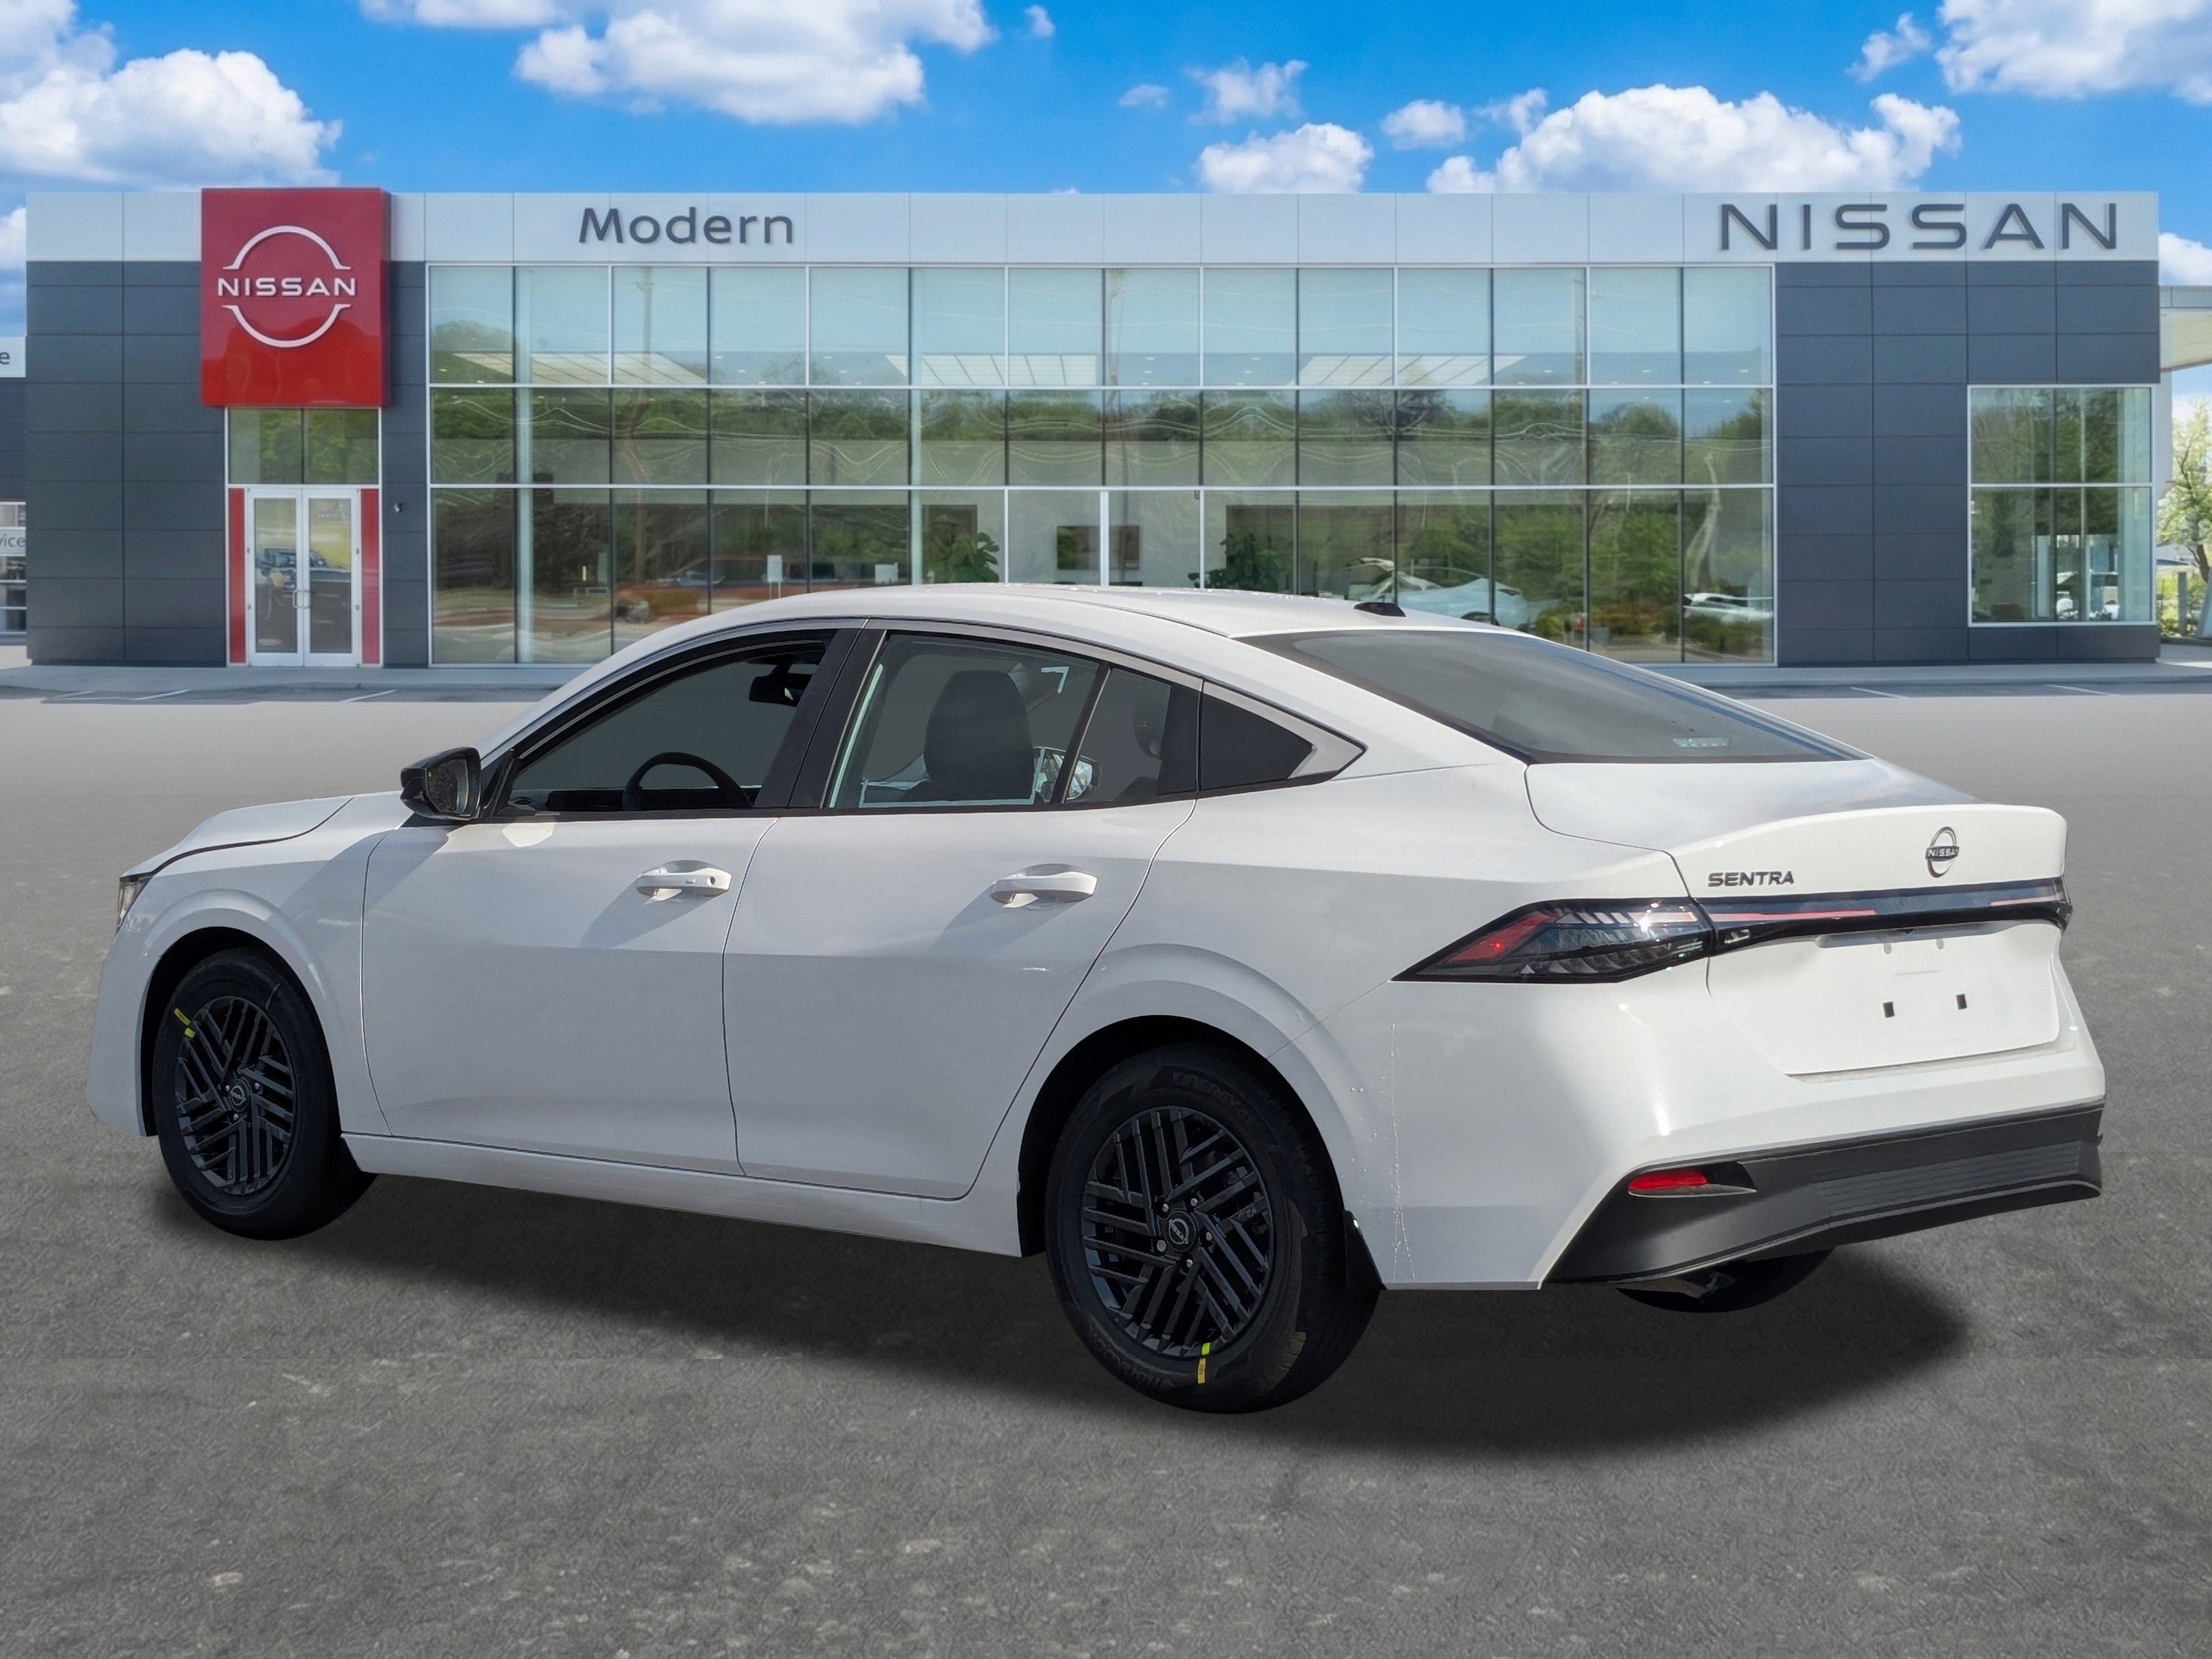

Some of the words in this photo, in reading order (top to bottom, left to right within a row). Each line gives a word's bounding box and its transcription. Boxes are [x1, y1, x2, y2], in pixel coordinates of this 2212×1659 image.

[579, 206, 793, 244] Modern
[1719, 202, 2117, 251] NISSAN
[218, 277, 356, 297] NISSAN
[1708, 871, 1795, 887] SENTRA
